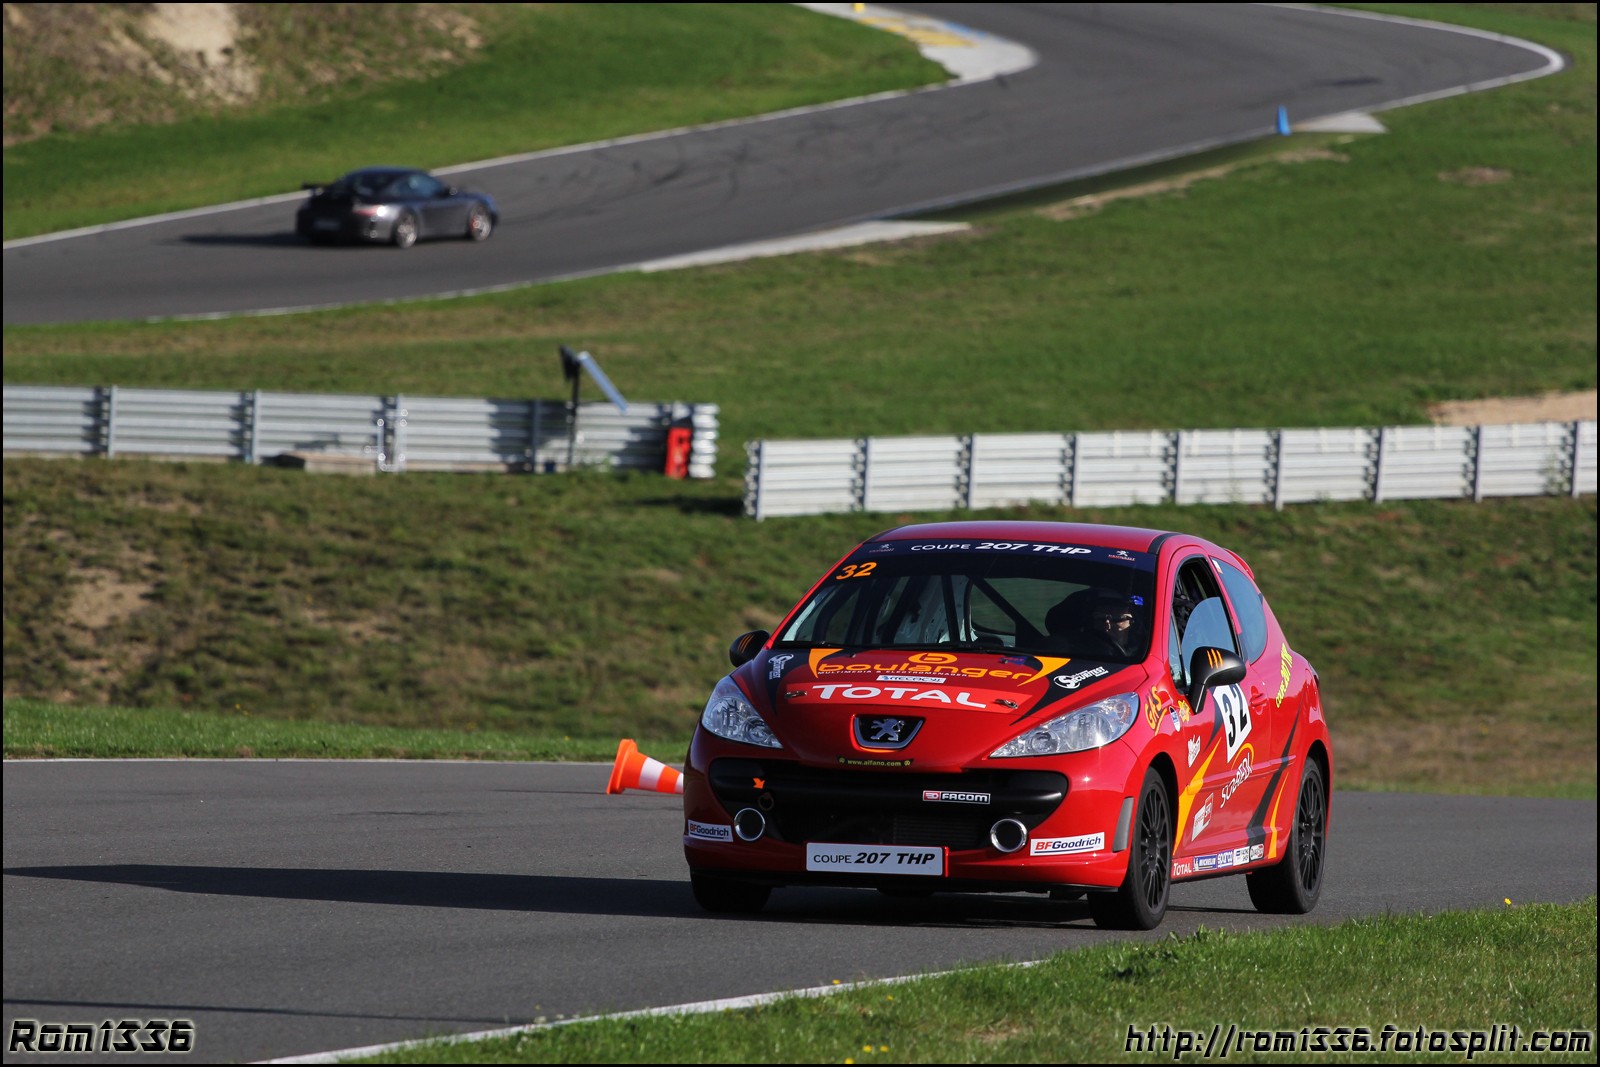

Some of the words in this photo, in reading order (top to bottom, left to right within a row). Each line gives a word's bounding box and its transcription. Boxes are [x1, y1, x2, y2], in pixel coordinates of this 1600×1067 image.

[911, 543, 970, 551] COUPE
[975, 542, 1028, 551] 207
[1031, 544, 1092, 555] THP
[836, 562, 877, 580] 32
[818, 663, 1032, 680] boulanger
[812, 684, 986, 708] TOTAL
[1145, 686, 1163, 730] GAS
[1222, 684, 1248, 748] 32
[941, 793, 988, 802] FACOM
[690, 823, 729, 836] BFGoodrich
[1035, 836, 1101, 850] BFGoodrich
[813, 855, 852, 863] COUPE
[854, 852, 891, 864] 207
[896, 853, 936, 865] THP
[1173, 862, 1192, 876] TOTAL
